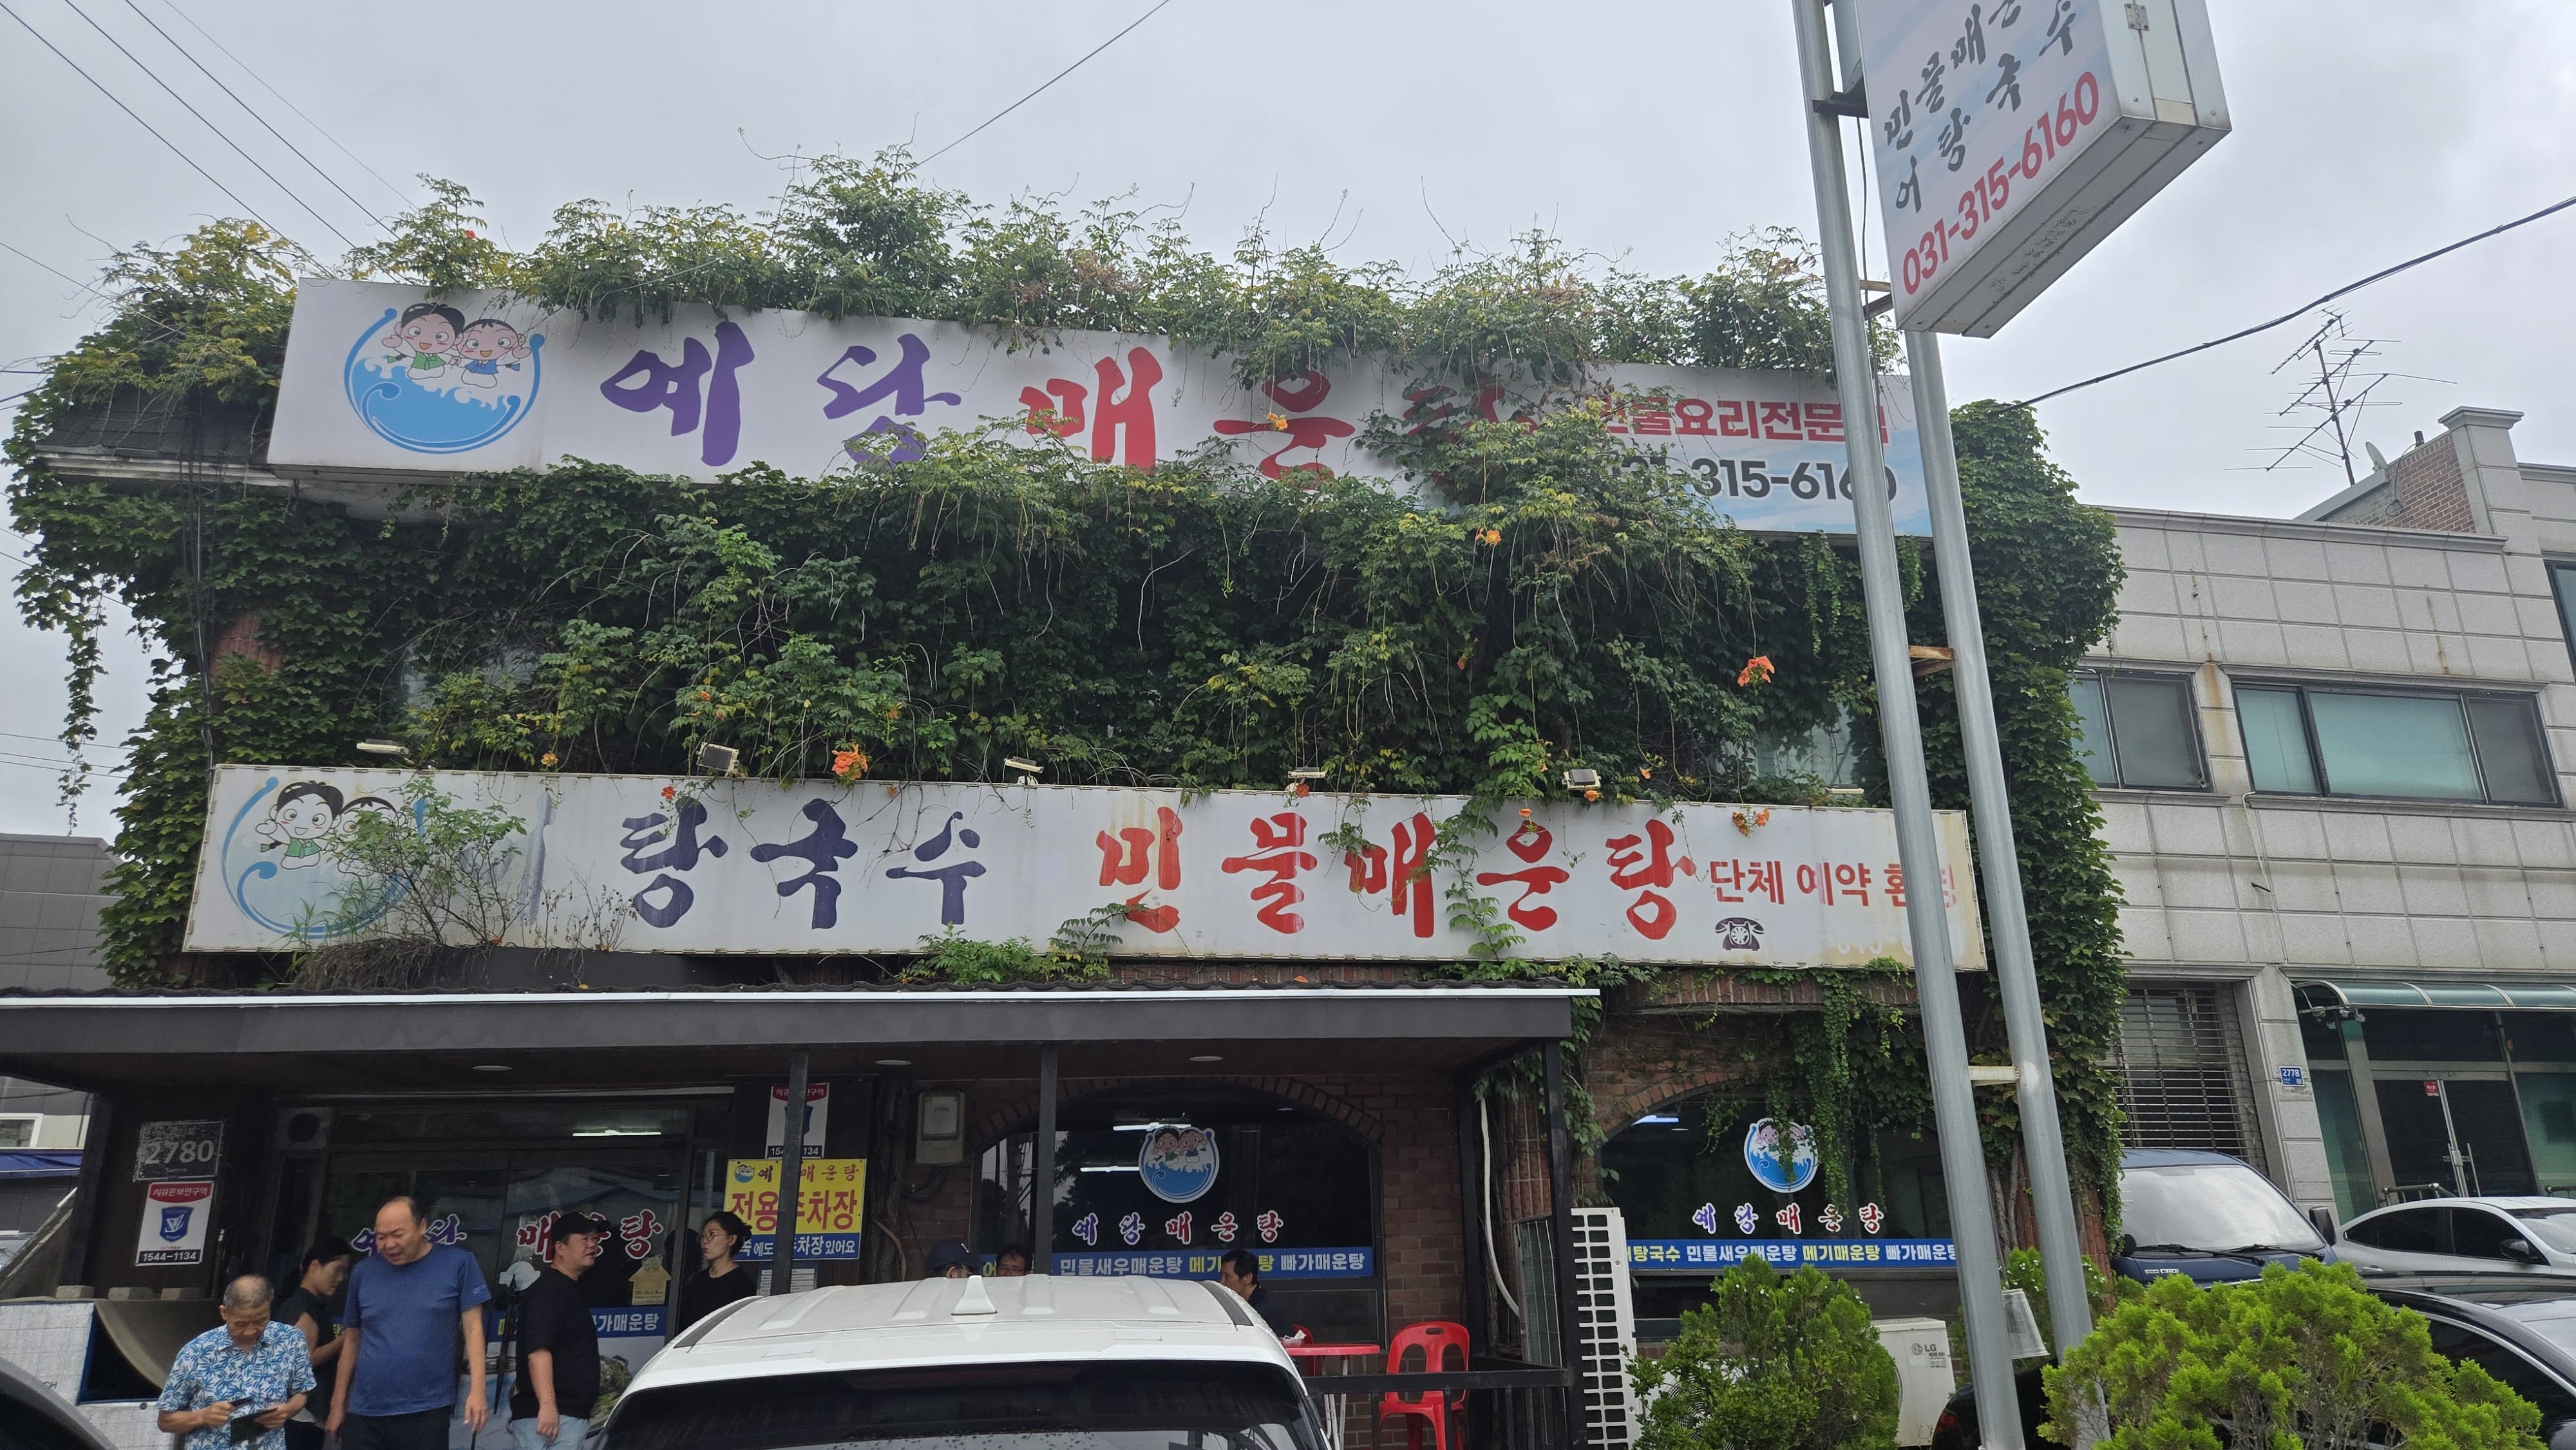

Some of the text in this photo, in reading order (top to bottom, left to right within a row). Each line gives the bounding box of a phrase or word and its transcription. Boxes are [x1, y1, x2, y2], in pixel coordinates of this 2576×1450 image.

[1902, 71, 2099, 295] 031-315-6160
[1600, 394, 1889, 444] 물요리전문
[1710, 859, 1785, 905] 단체
[1797, 861, 1872, 907] 예약
[145, 1140, 214, 1164] 2780
[142, 1251, 196, 1261] 1544-1134
[1059, 1252, 1365, 1276] 민물새우매운탕 메기탕 빠가매운탕
[1686, 1245, 1797, 1263] 민물새우매운탕
[1802, 1245, 1880, 1261] 메기매운탕
[592, 1312, 659, 1333] 가매운탕
[1924, 1343, 1937, 1352] LG
